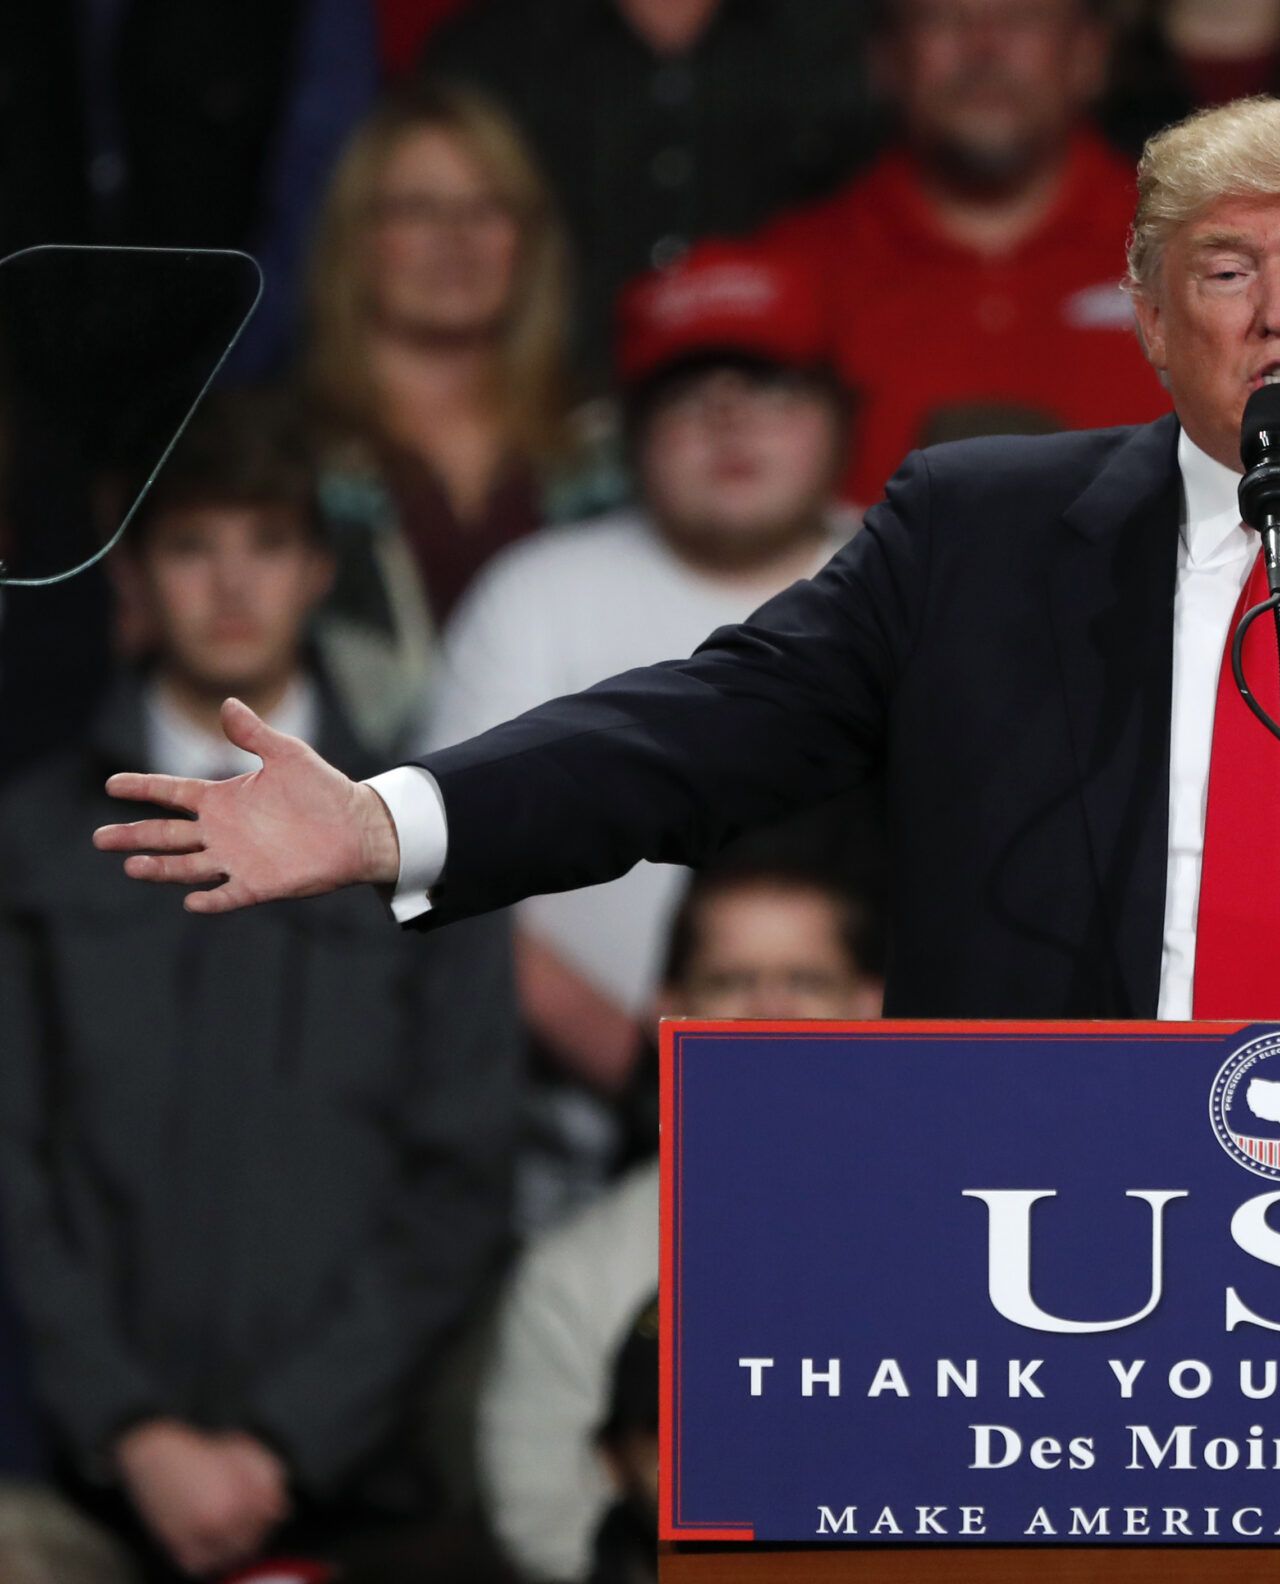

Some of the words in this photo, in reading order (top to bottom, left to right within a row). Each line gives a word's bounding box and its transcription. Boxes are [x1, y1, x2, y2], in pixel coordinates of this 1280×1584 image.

[1225, 1057, 1258, 1111] PRESIDENT
[739, 1357, 1046, 1398] THANK
[1109, 1359, 1278, 1400] YOU
[968, 1424, 1096, 1470] Des
[815, 1505, 988, 1535] MAKE
